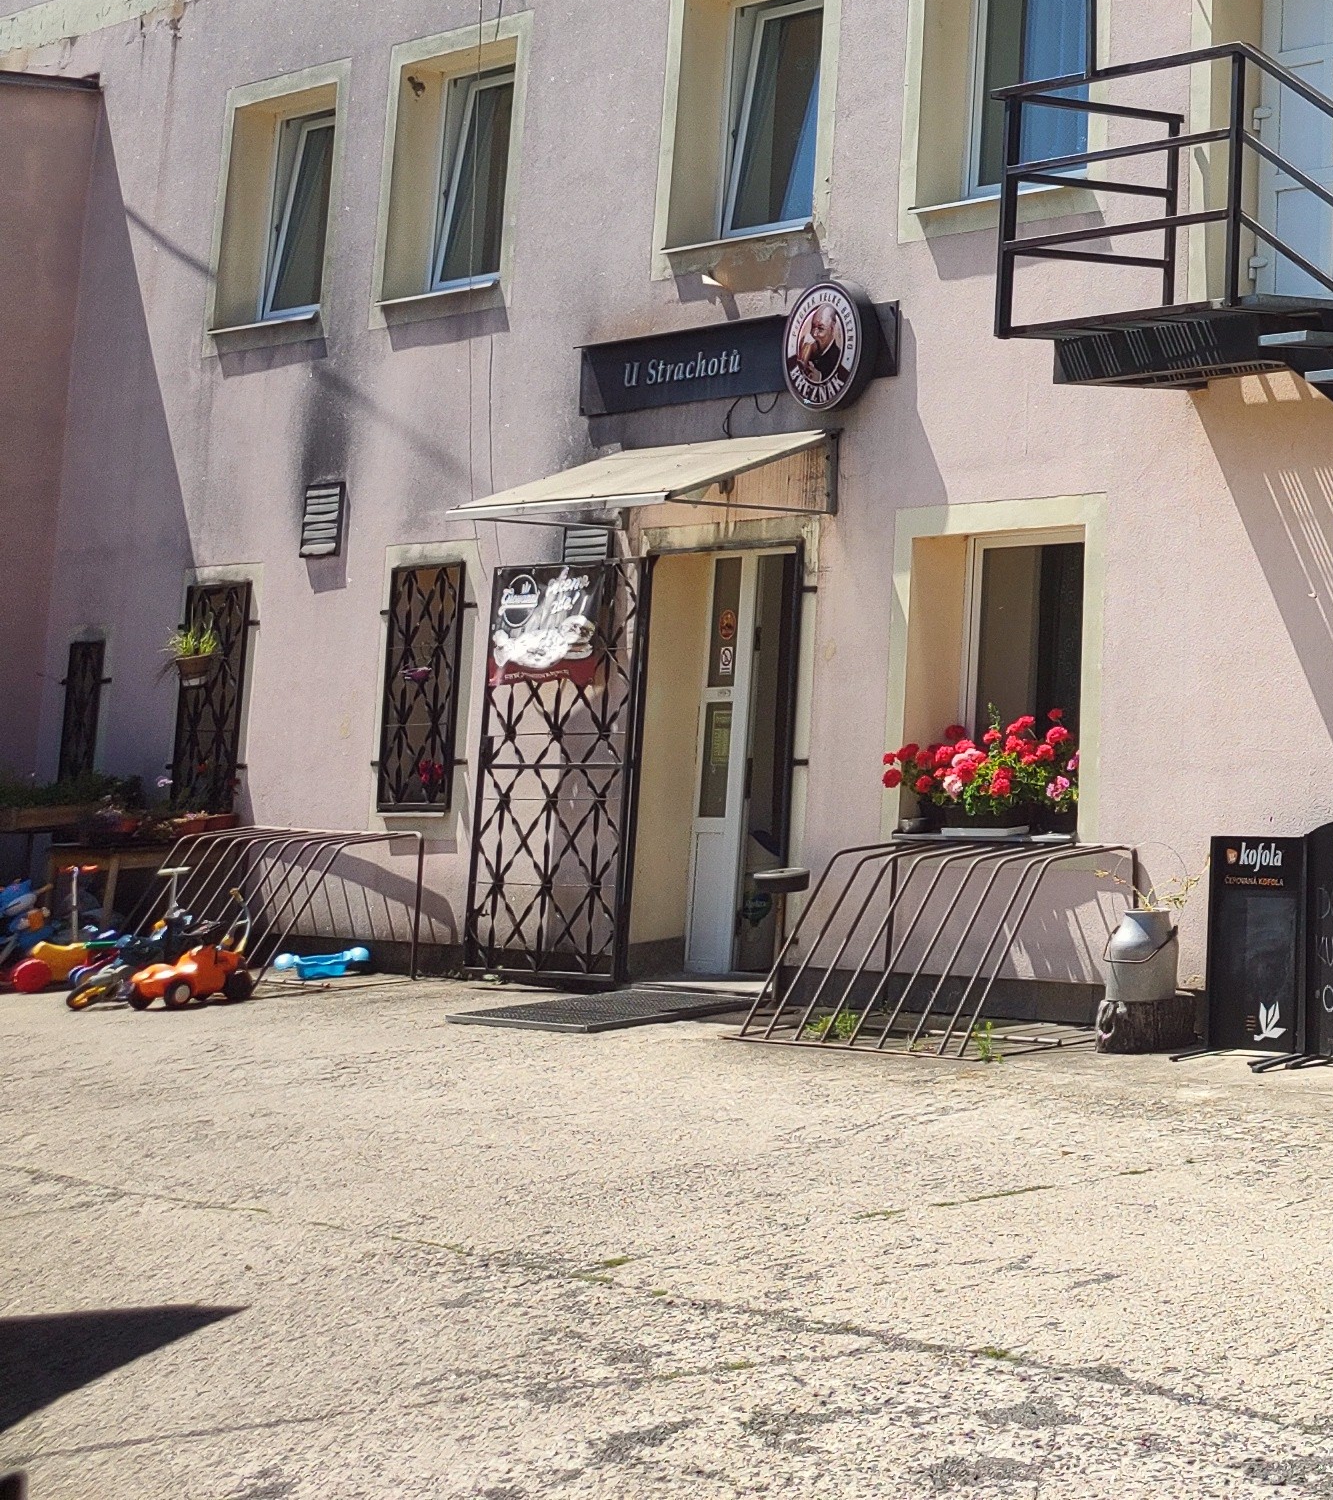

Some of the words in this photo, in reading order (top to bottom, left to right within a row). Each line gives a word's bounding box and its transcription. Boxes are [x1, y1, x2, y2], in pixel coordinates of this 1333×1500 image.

[624, 362, 639, 387] U
[646, 349, 740, 385] Strachotů
[1239, 842, 1283, 872] kofola
